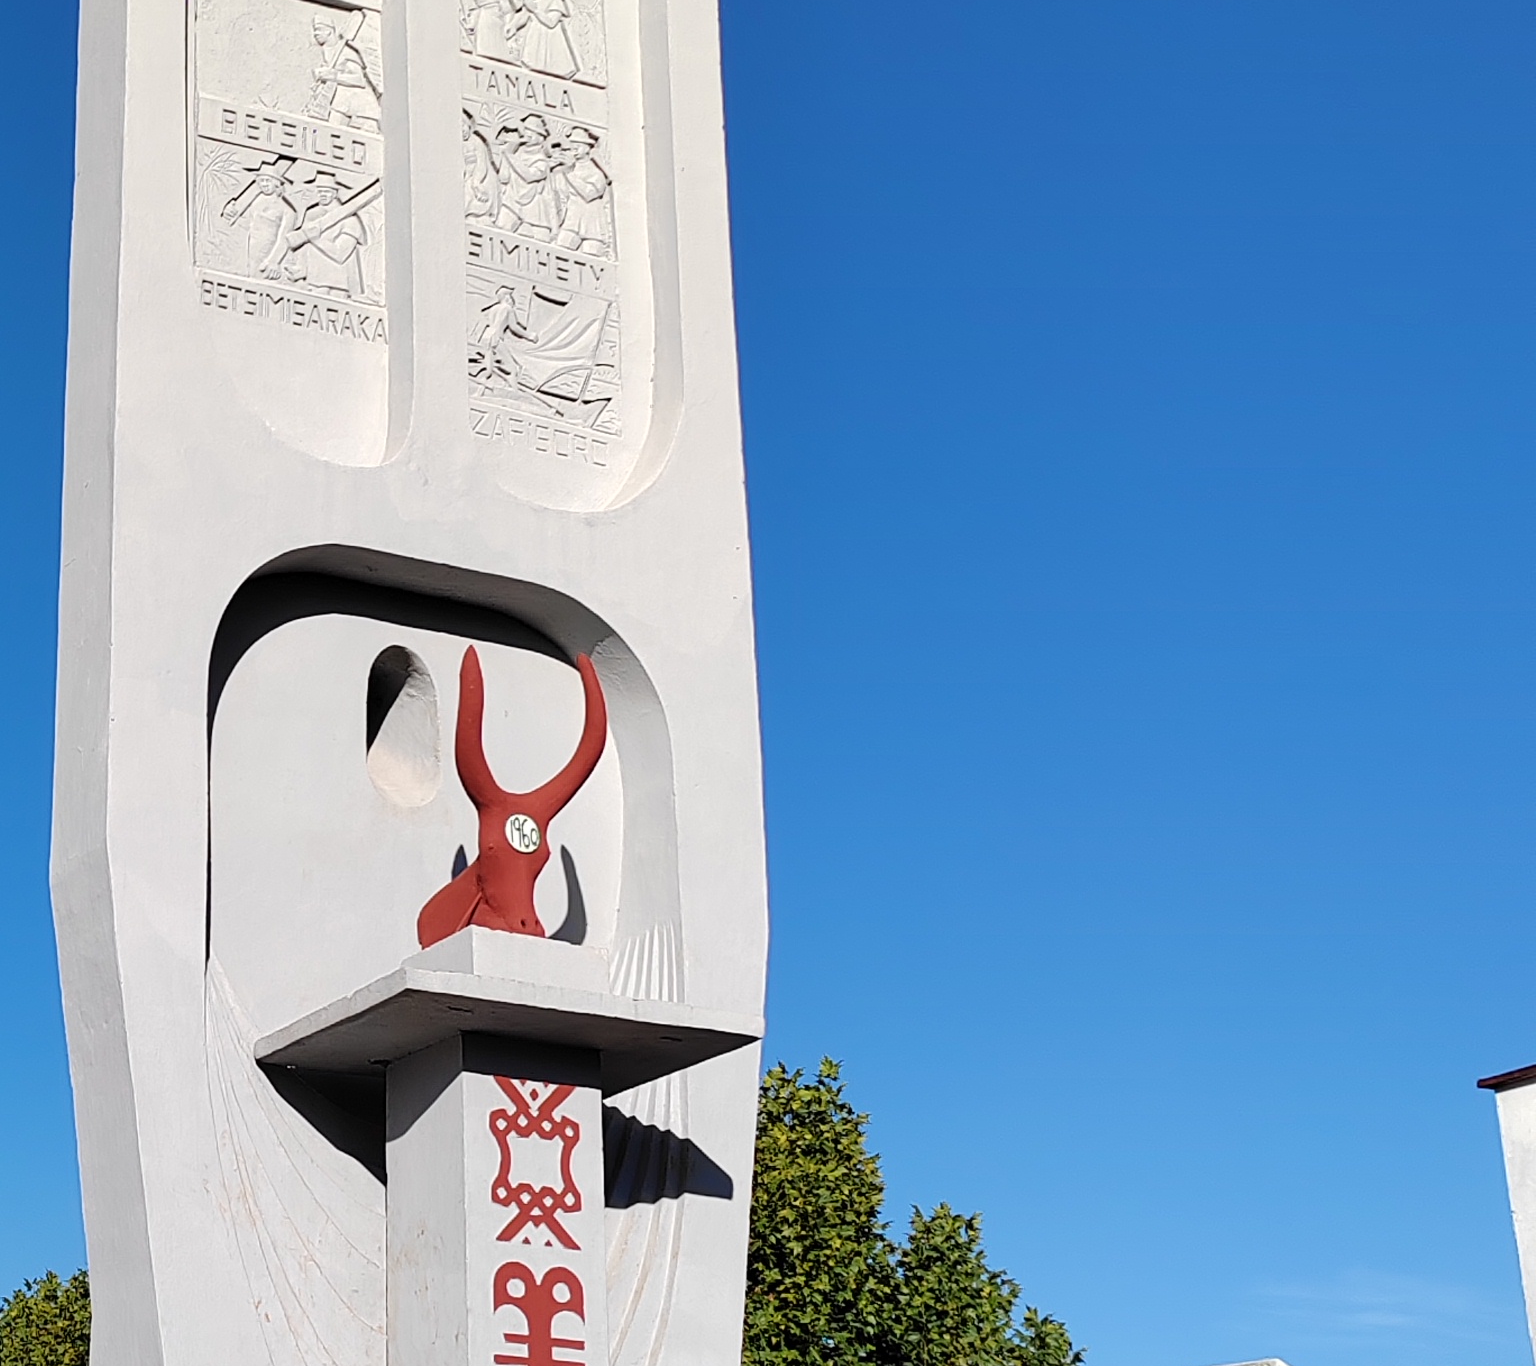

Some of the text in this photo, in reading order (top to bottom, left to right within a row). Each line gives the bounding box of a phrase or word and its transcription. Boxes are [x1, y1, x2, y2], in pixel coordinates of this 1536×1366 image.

[468, 64, 575, 114] TANALA
[221, 108, 367, 166] BETSILEO
[468, 231, 604, 291] SIMIHETY
[510, 817, 539, 849] 1960
